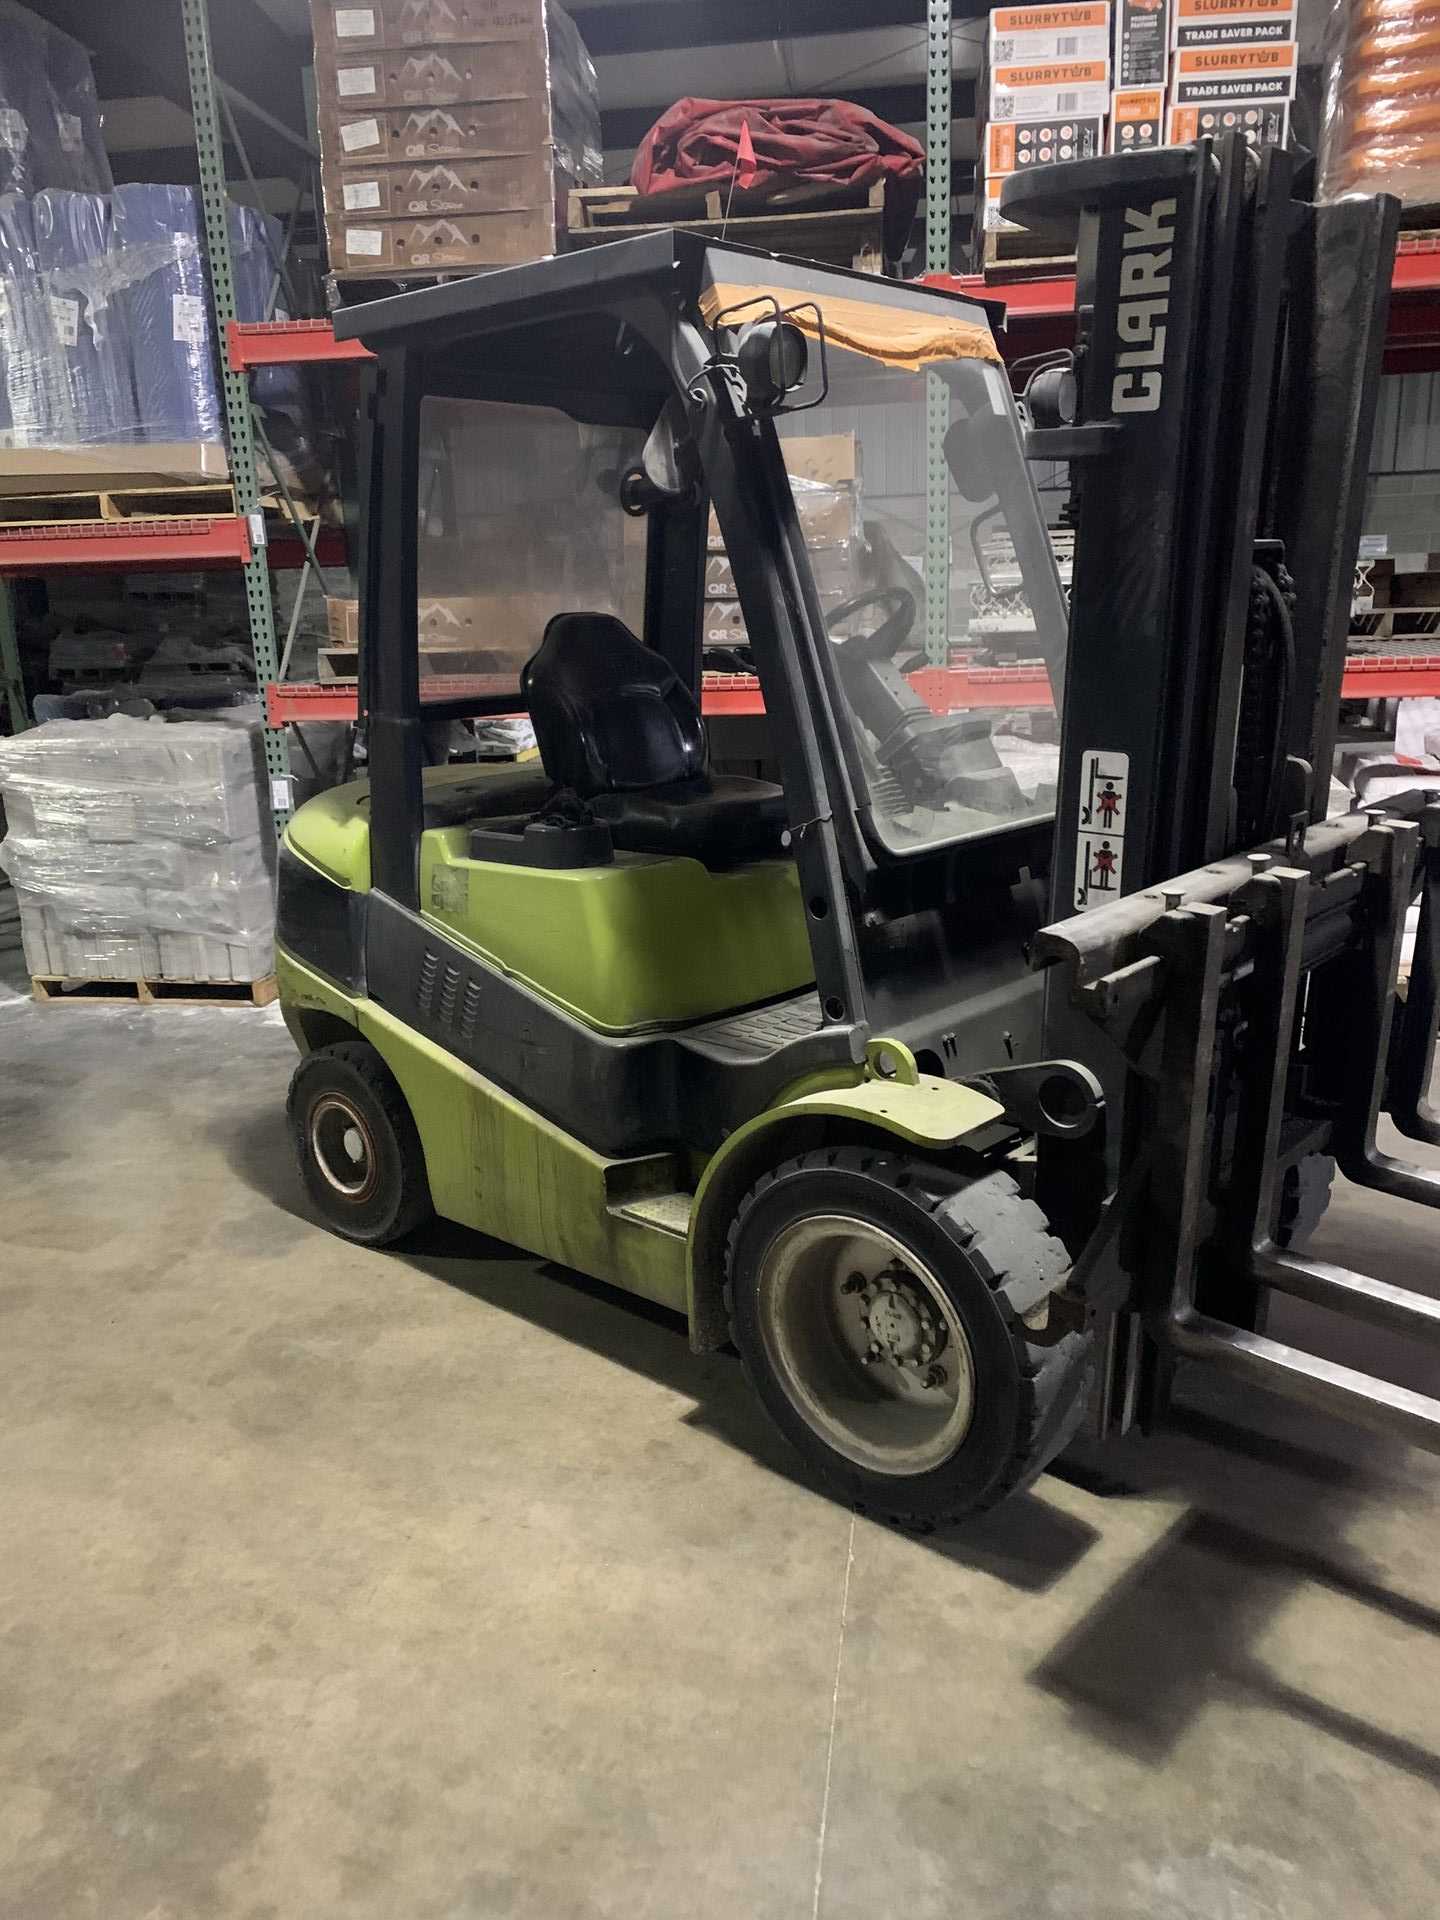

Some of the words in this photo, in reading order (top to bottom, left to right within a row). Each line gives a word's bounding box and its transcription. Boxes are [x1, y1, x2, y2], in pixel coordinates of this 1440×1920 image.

[1009, 9, 1092, 25] SLURRYTUB
[1185, 30, 1218, 40] TRADE
[1220, 27, 1253, 39] SAVER
[1255, 25, 1283, 37] PACK
[1193, 50, 1280, 67] SLURRYTUB
[1009, 66, 1092, 82] SLURRYTUB
[1186, 85, 1219, 96] TRADE
[1221, 83, 1253, 95] SAVER
[1255, 81, 1283, 92] PACK
[408, 200, 428, 212] QR
[411, 254, 430, 265] QR
[1112, 198, 1177, 413] CLARK
[708, 583, 728, 594] QR
[708, 629, 728, 640] QR
